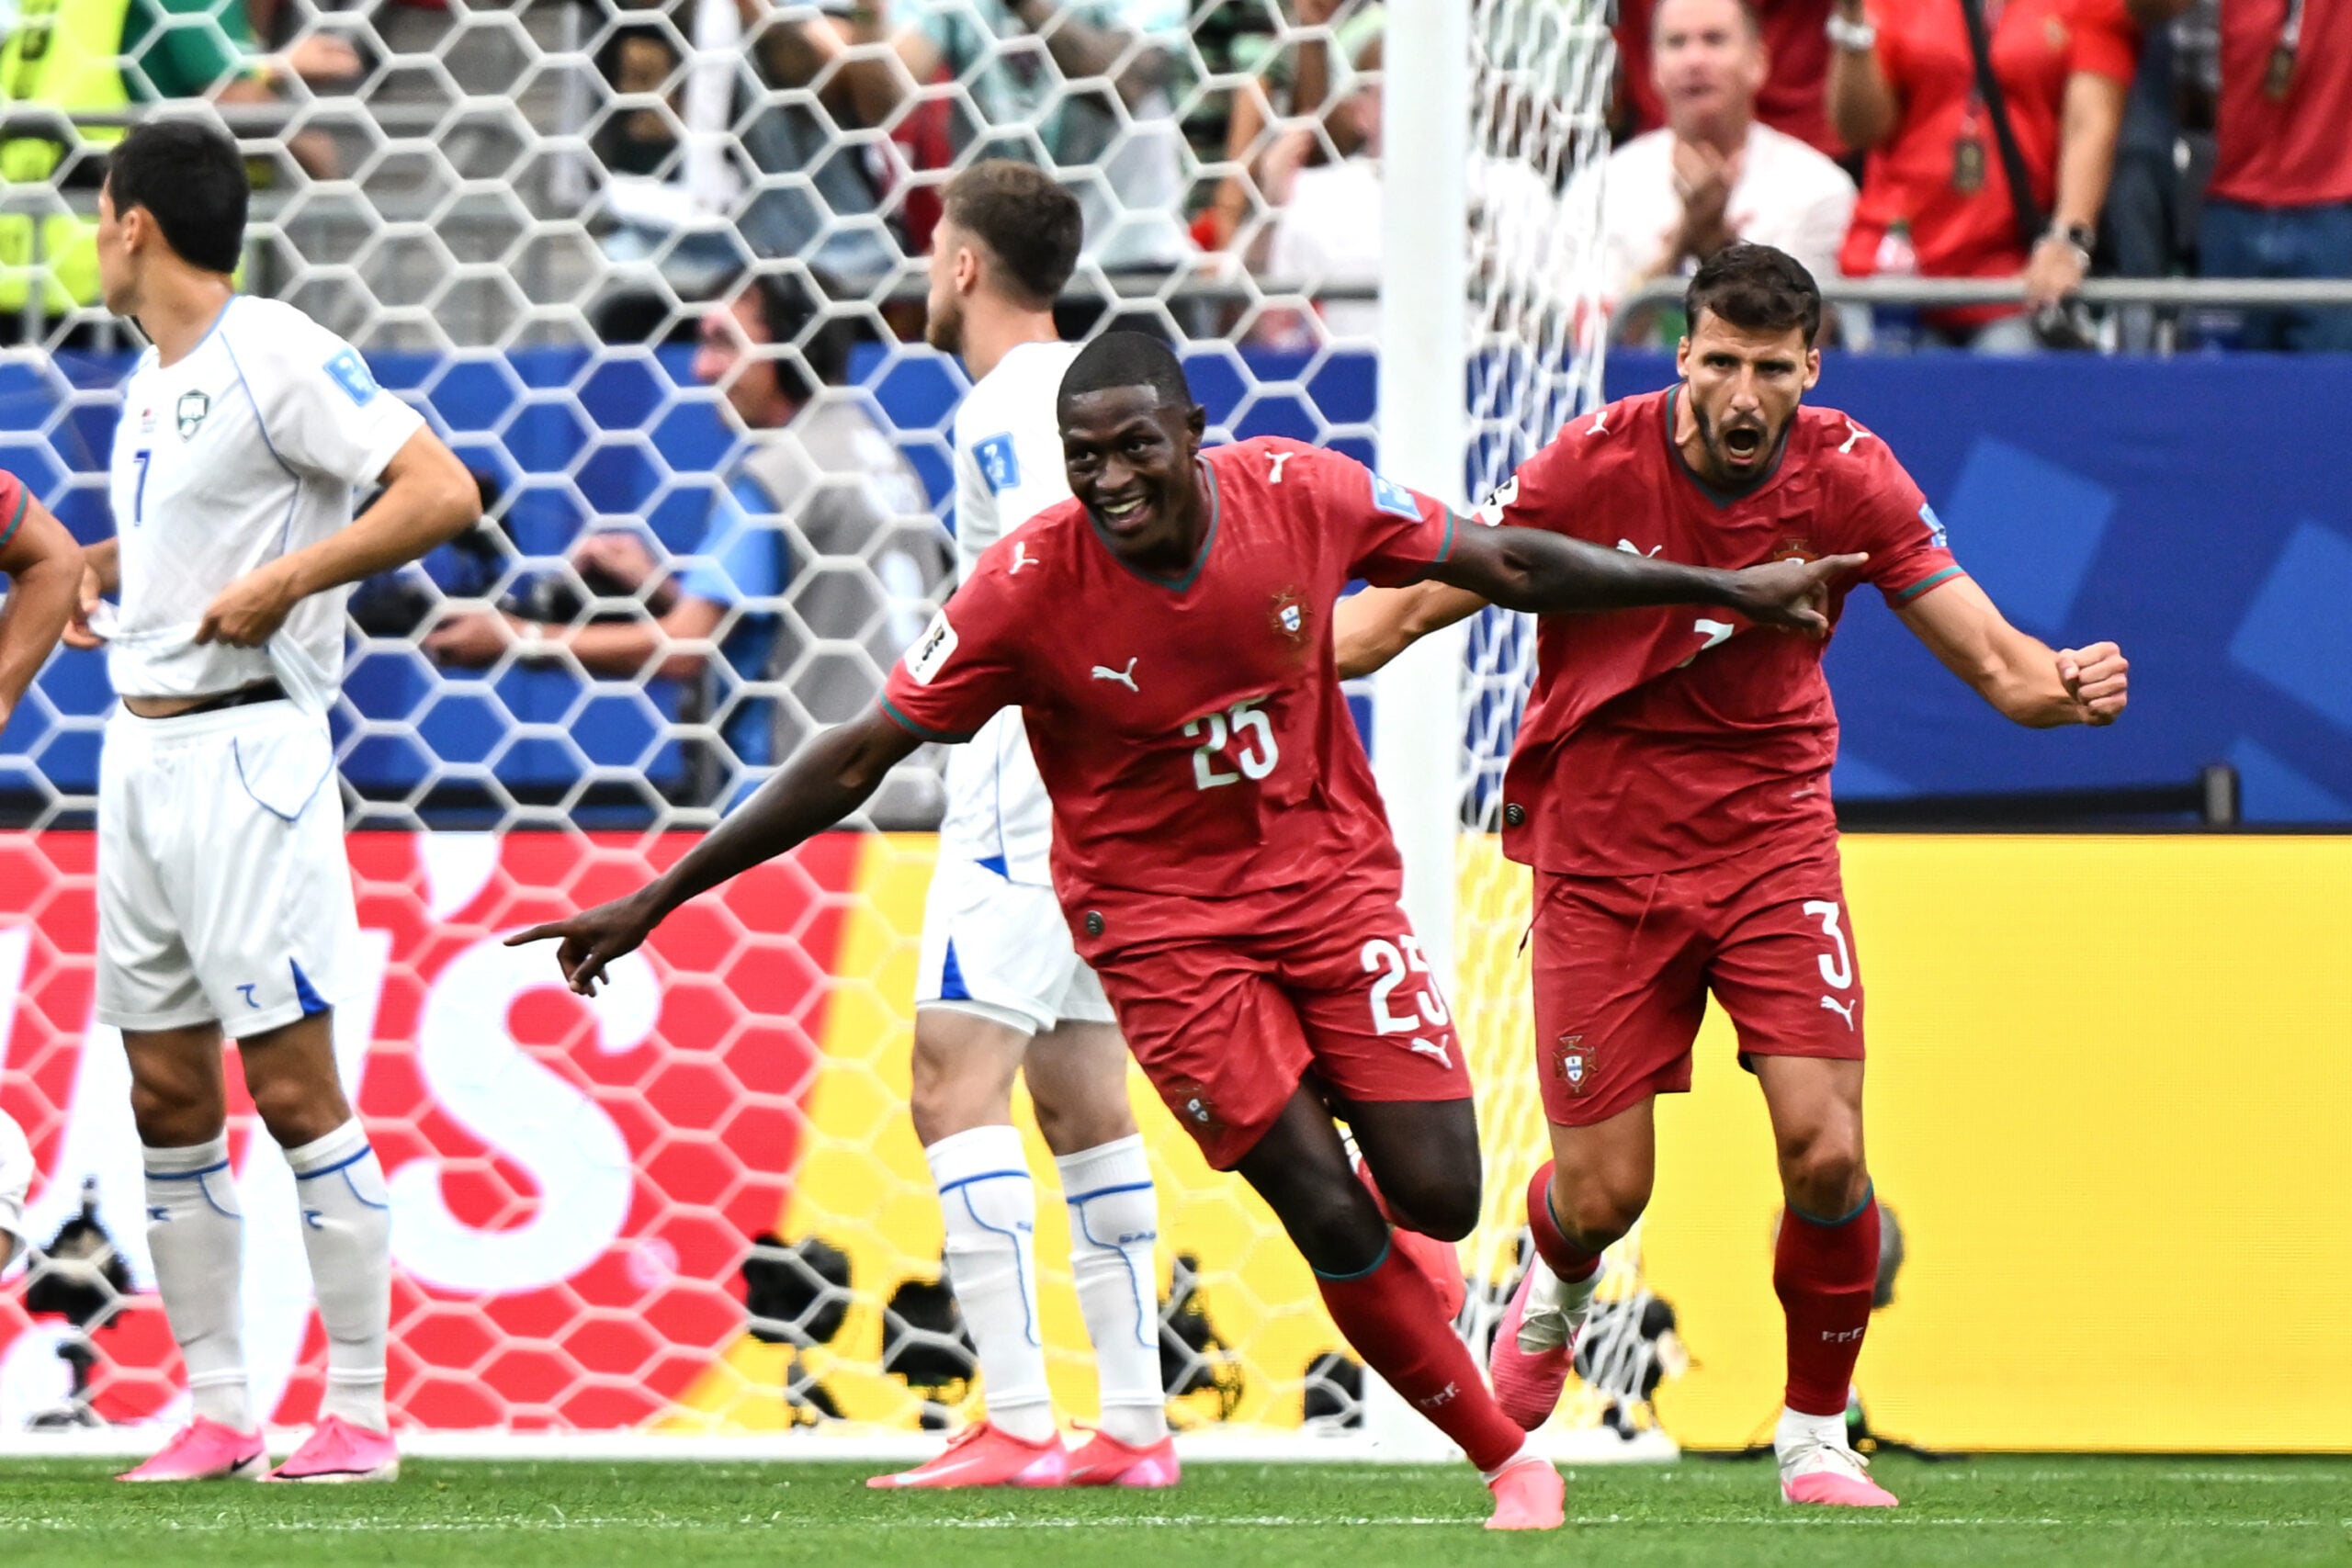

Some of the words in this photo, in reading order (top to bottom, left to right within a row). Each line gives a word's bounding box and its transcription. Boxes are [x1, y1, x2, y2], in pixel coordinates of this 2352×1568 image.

[133, 448, 153, 527] 7
[1183, 694, 1280, 790] 25
[1360, 933, 1451, 1036] 25
[1803, 900, 1853, 989] 3
